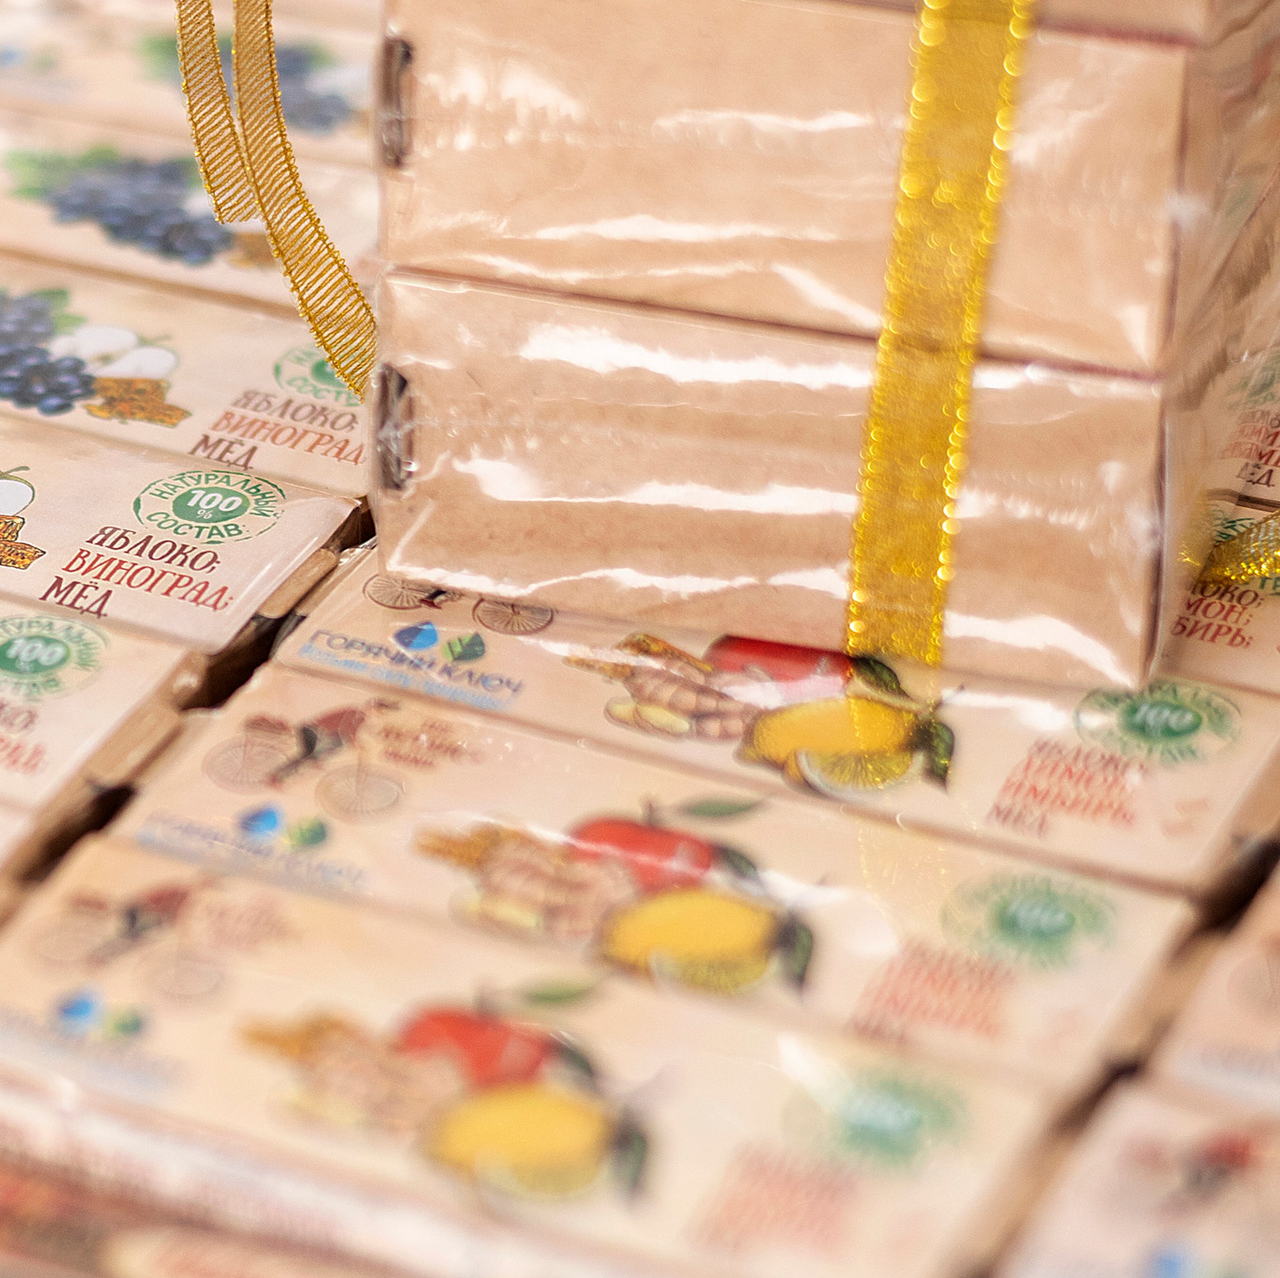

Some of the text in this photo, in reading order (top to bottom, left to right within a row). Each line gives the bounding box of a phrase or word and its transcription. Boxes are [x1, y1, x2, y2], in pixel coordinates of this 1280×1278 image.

[188, 434, 259, 471] МЁД
[149, 473, 285, 519] НАТУРАЛЬНЫЙ
[186, 489, 243, 512] 100
[195, 508, 213, 520] %
[85, 525, 222, 573] ЯБЛОКО;
[39, 575, 113, 619] МЁД
[61, 548, 234, 612] ВИНОГРАД;
[1170, 616, 1253, 648] БИРЬ;
[5, 636, 67, 666] 100
